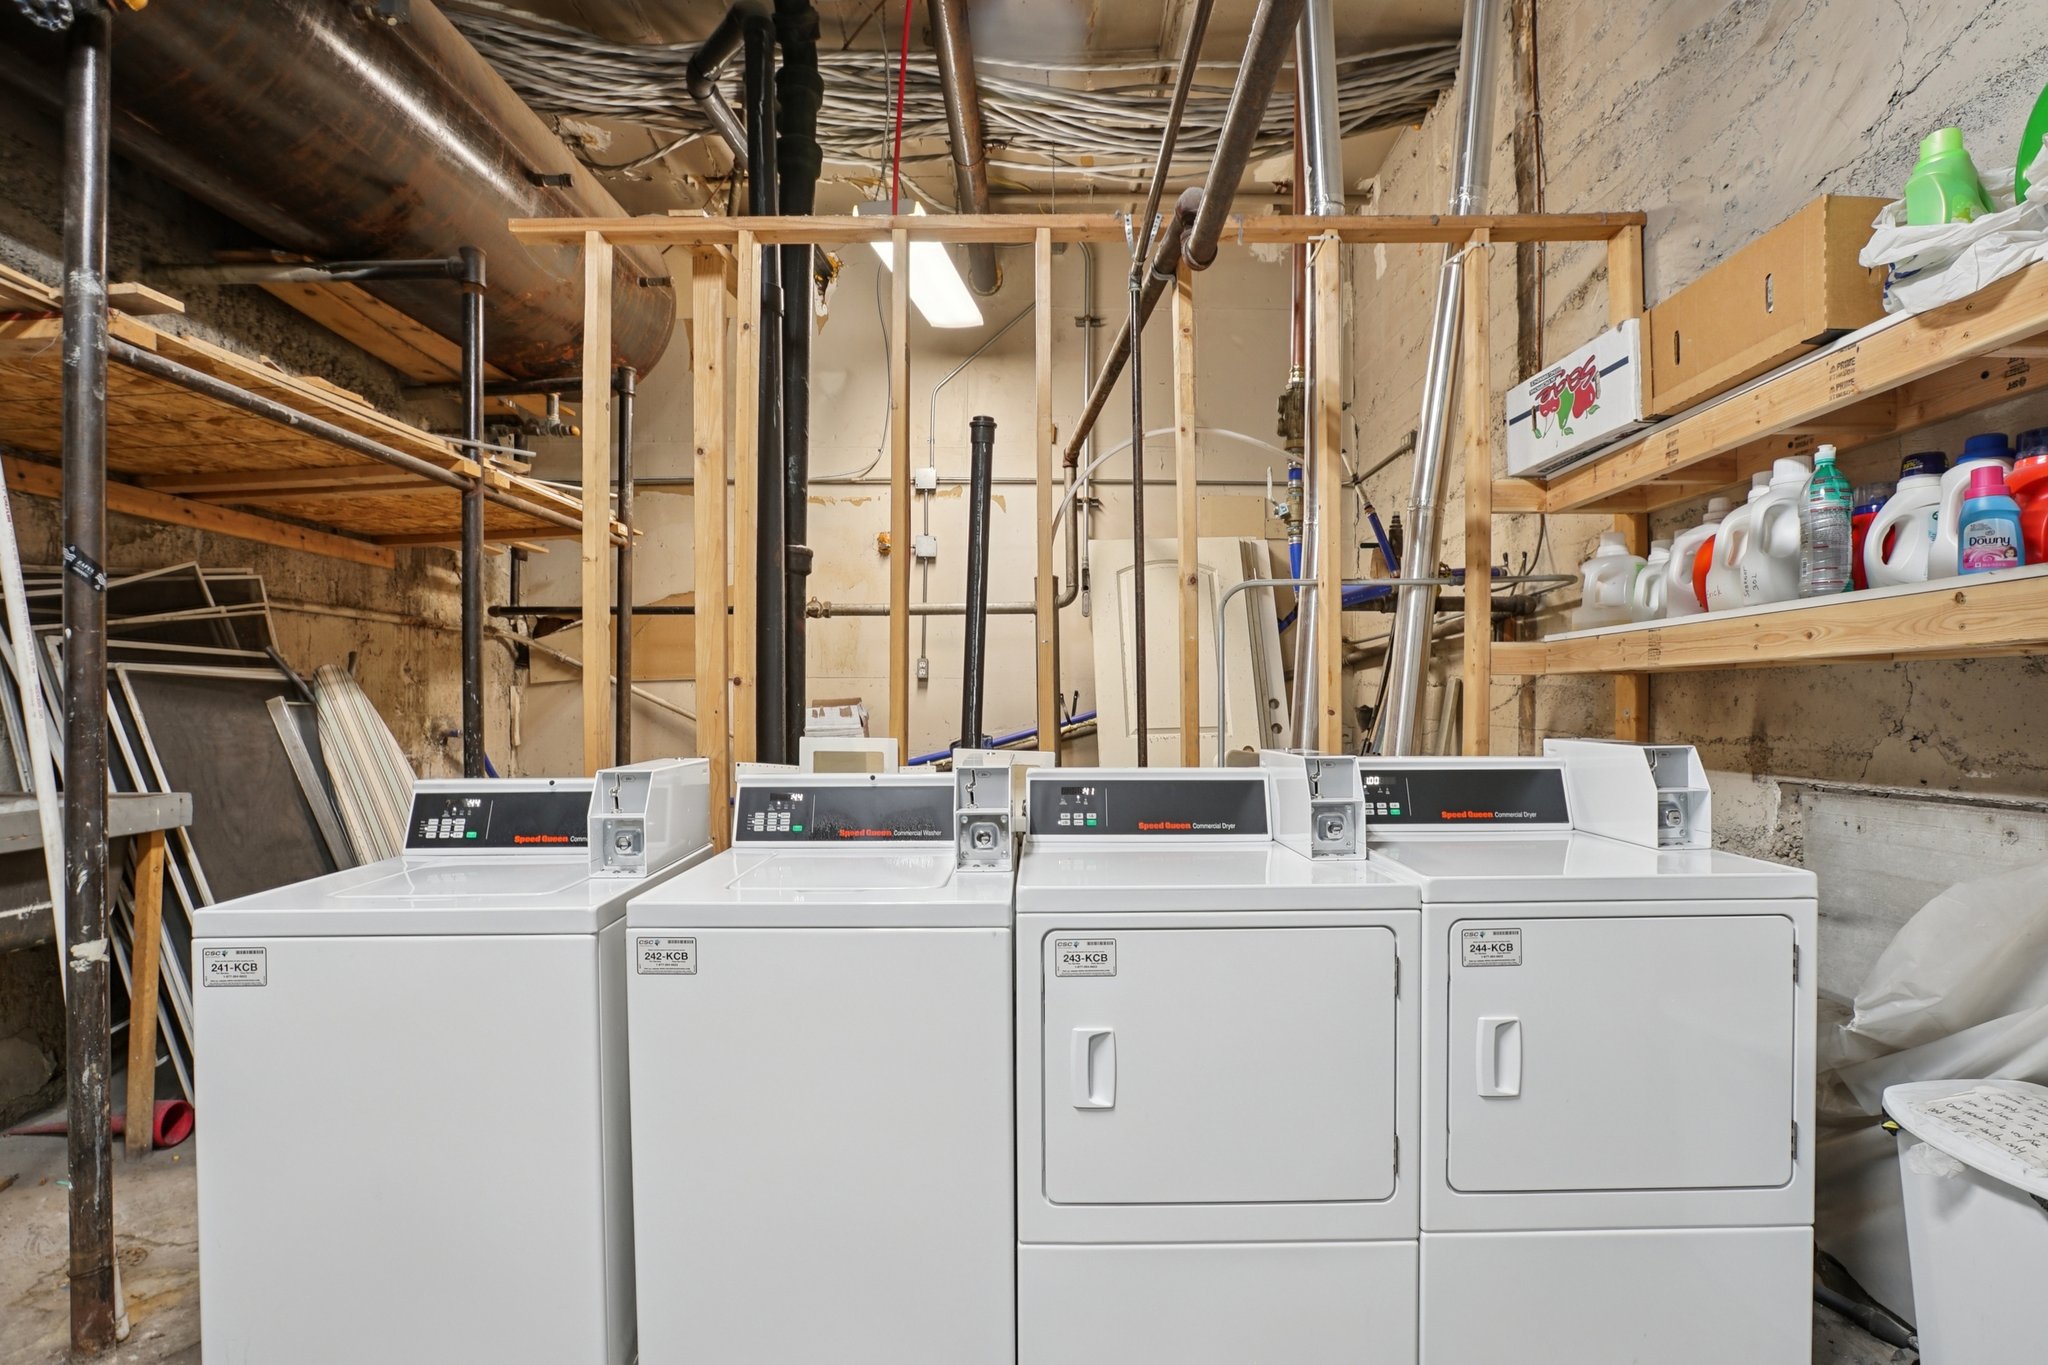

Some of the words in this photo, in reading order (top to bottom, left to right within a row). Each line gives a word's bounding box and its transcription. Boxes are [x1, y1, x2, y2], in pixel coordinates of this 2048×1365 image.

[1969, 536, 2011, 547] Downy
[1441, 811, 1467, 819] Speed
[1138, 822, 1164, 830] Speed
[839, 829, 865, 837] Speed
[514, 835, 541, 844] Speed
[542, 834, 568, 843] Queen
[1469, 943, 1514, 953] 244-KCB
[644, 951, 689, 961] 242-KCB
[1063, 953, 1108, 963] 243-KCB
[211, 962, 258, 972] 241-KCB
